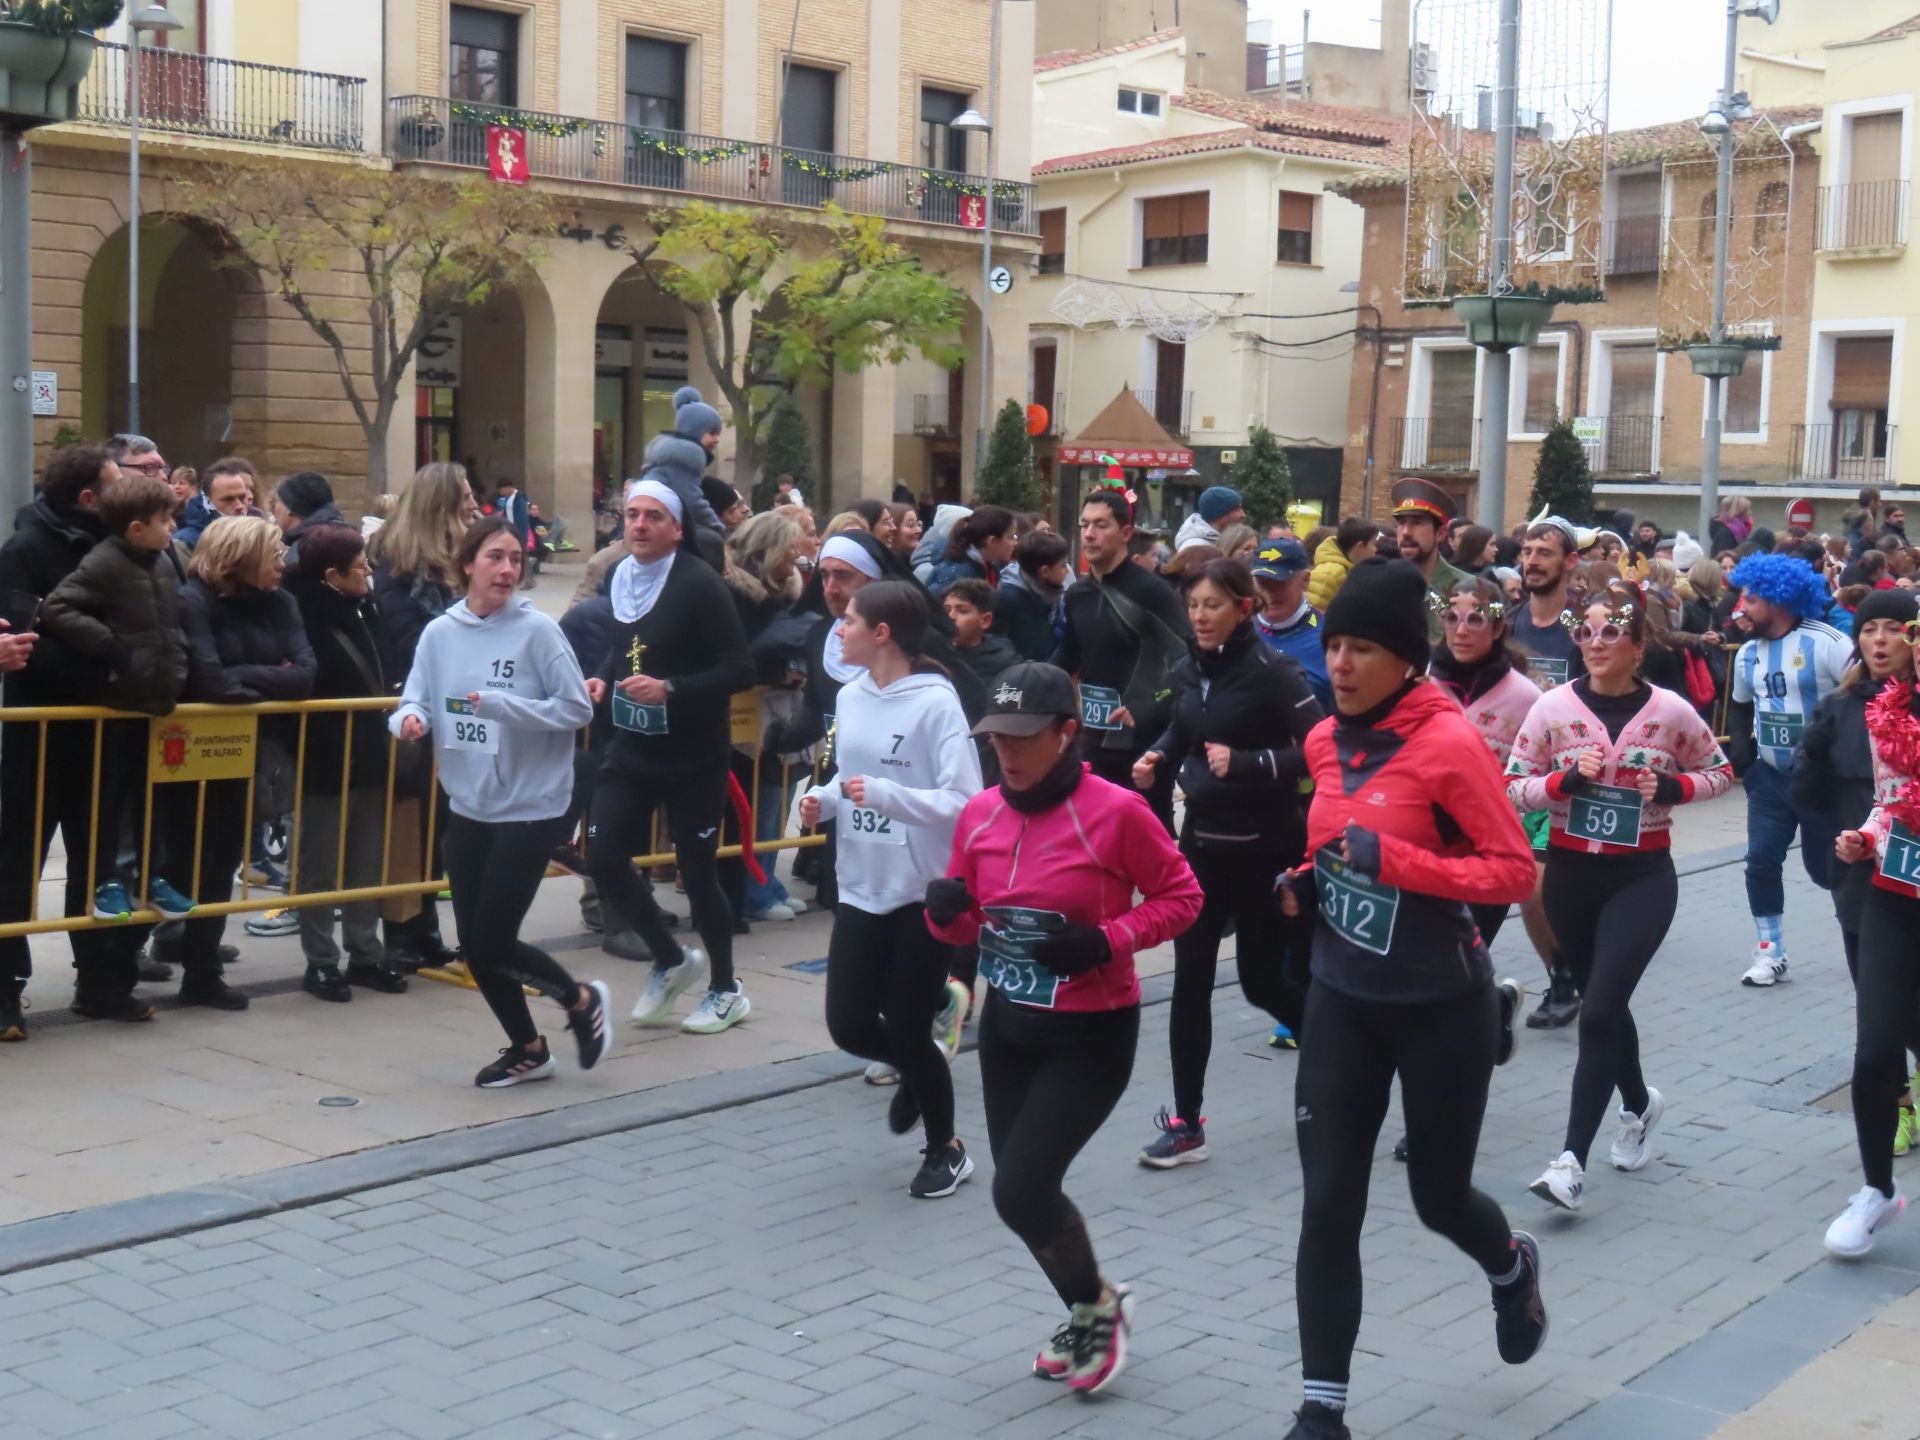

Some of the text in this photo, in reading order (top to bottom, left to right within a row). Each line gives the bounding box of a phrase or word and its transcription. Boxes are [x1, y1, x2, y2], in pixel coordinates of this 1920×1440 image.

[491, 659, 515, 679] 15
[1762, 671, 1788, 699] 10
[625, 704, 649, 729] 70
[1085, 701, 1112, 725] 297
[192, 734, 251, 746] AYUNTAMIENTO
[455, 721, 488, 744] 926
[1770, 725, 1790, 745] 18
[201, 747, 242, 758] DE ALFARO
[891, 734, 905, 755] 7
[852, 809, 892, 834] 932
[1585, 805, 1618, 836] 59
[1325, 882, 1376, 939] 312
